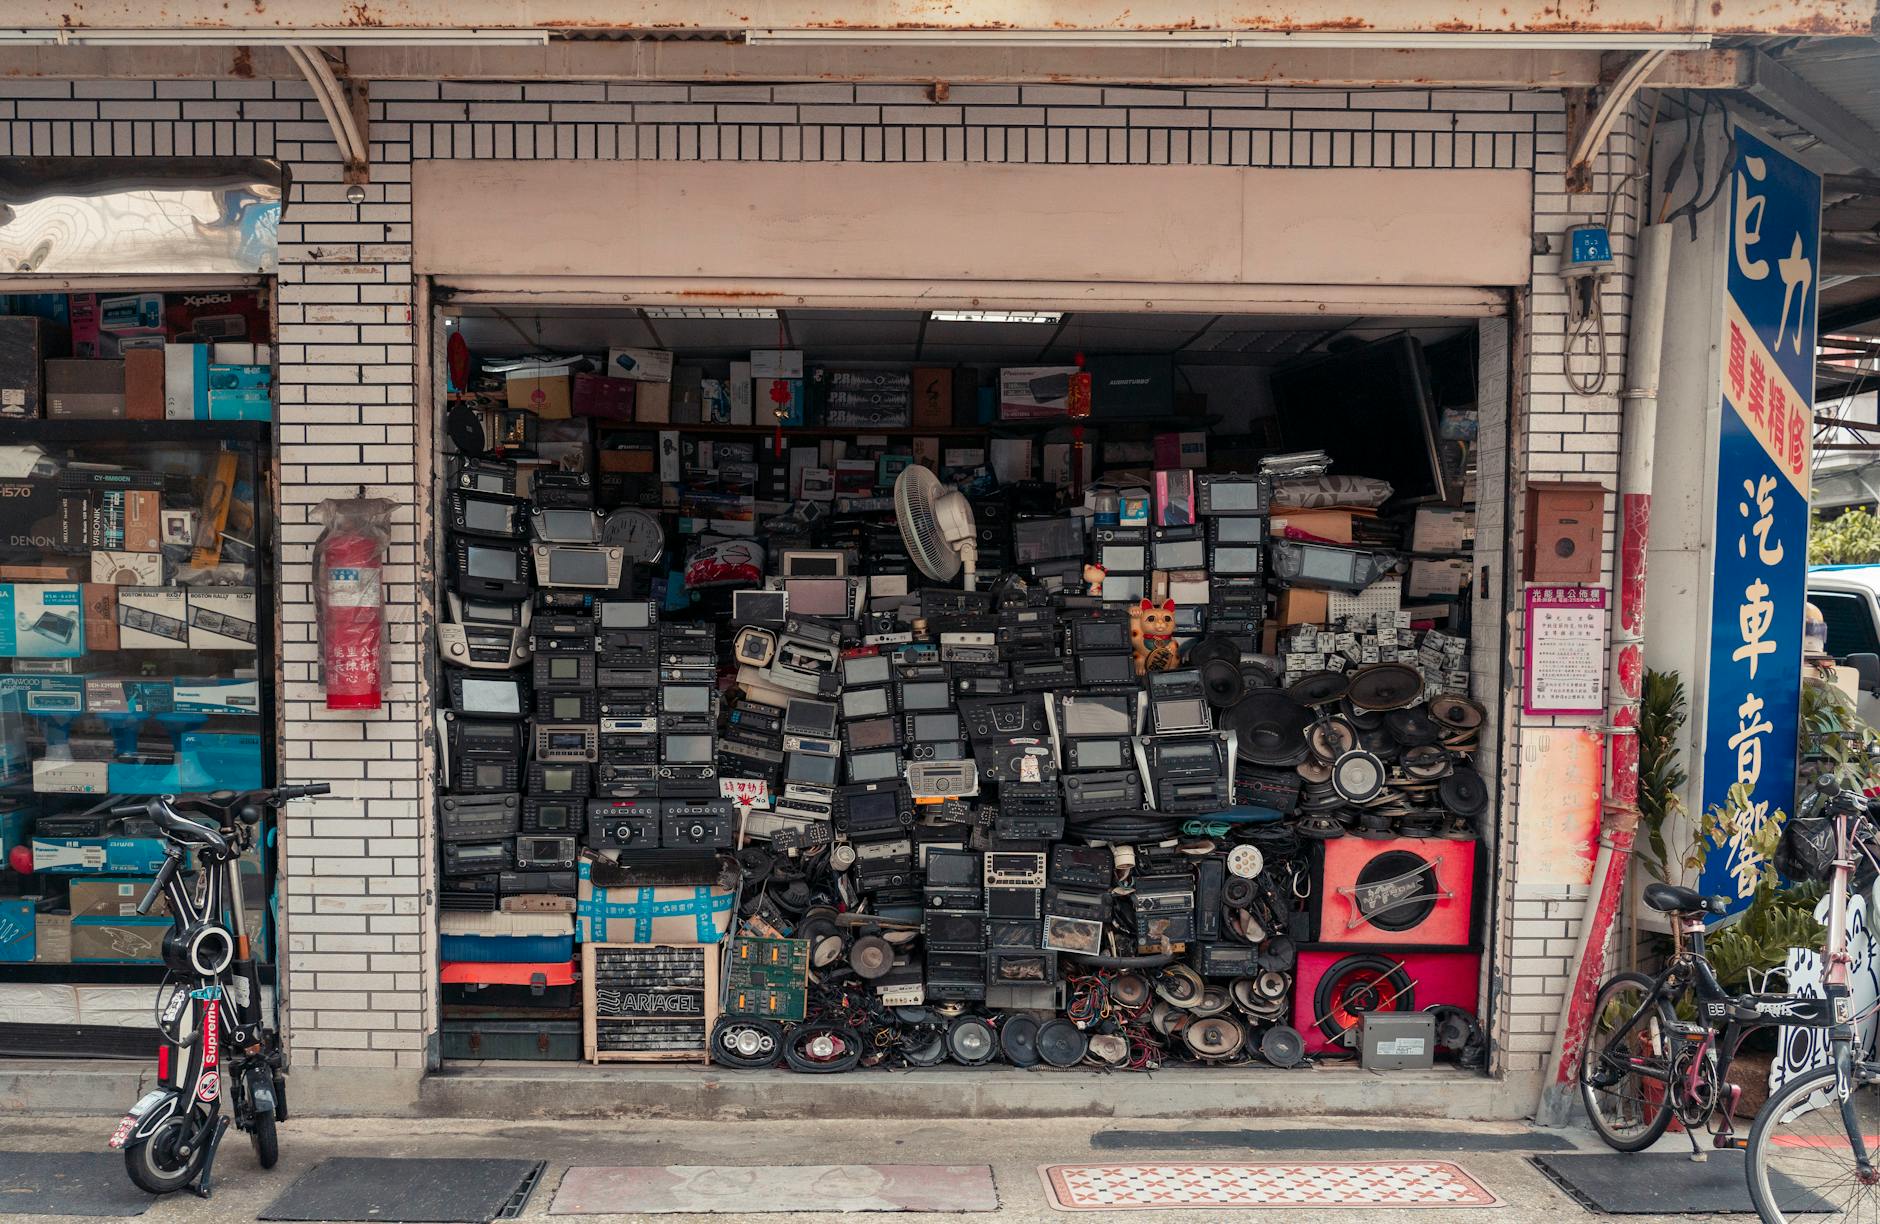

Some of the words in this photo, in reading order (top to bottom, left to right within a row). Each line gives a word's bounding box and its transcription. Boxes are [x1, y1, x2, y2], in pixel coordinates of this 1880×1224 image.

[10, 536, 55, 547] DENON
[1726, 474, 1783, 899] 汽車音響
[622, 992, 700, 1013] ARIAGEL
[206, 1002, 217, 1064] Supreme
